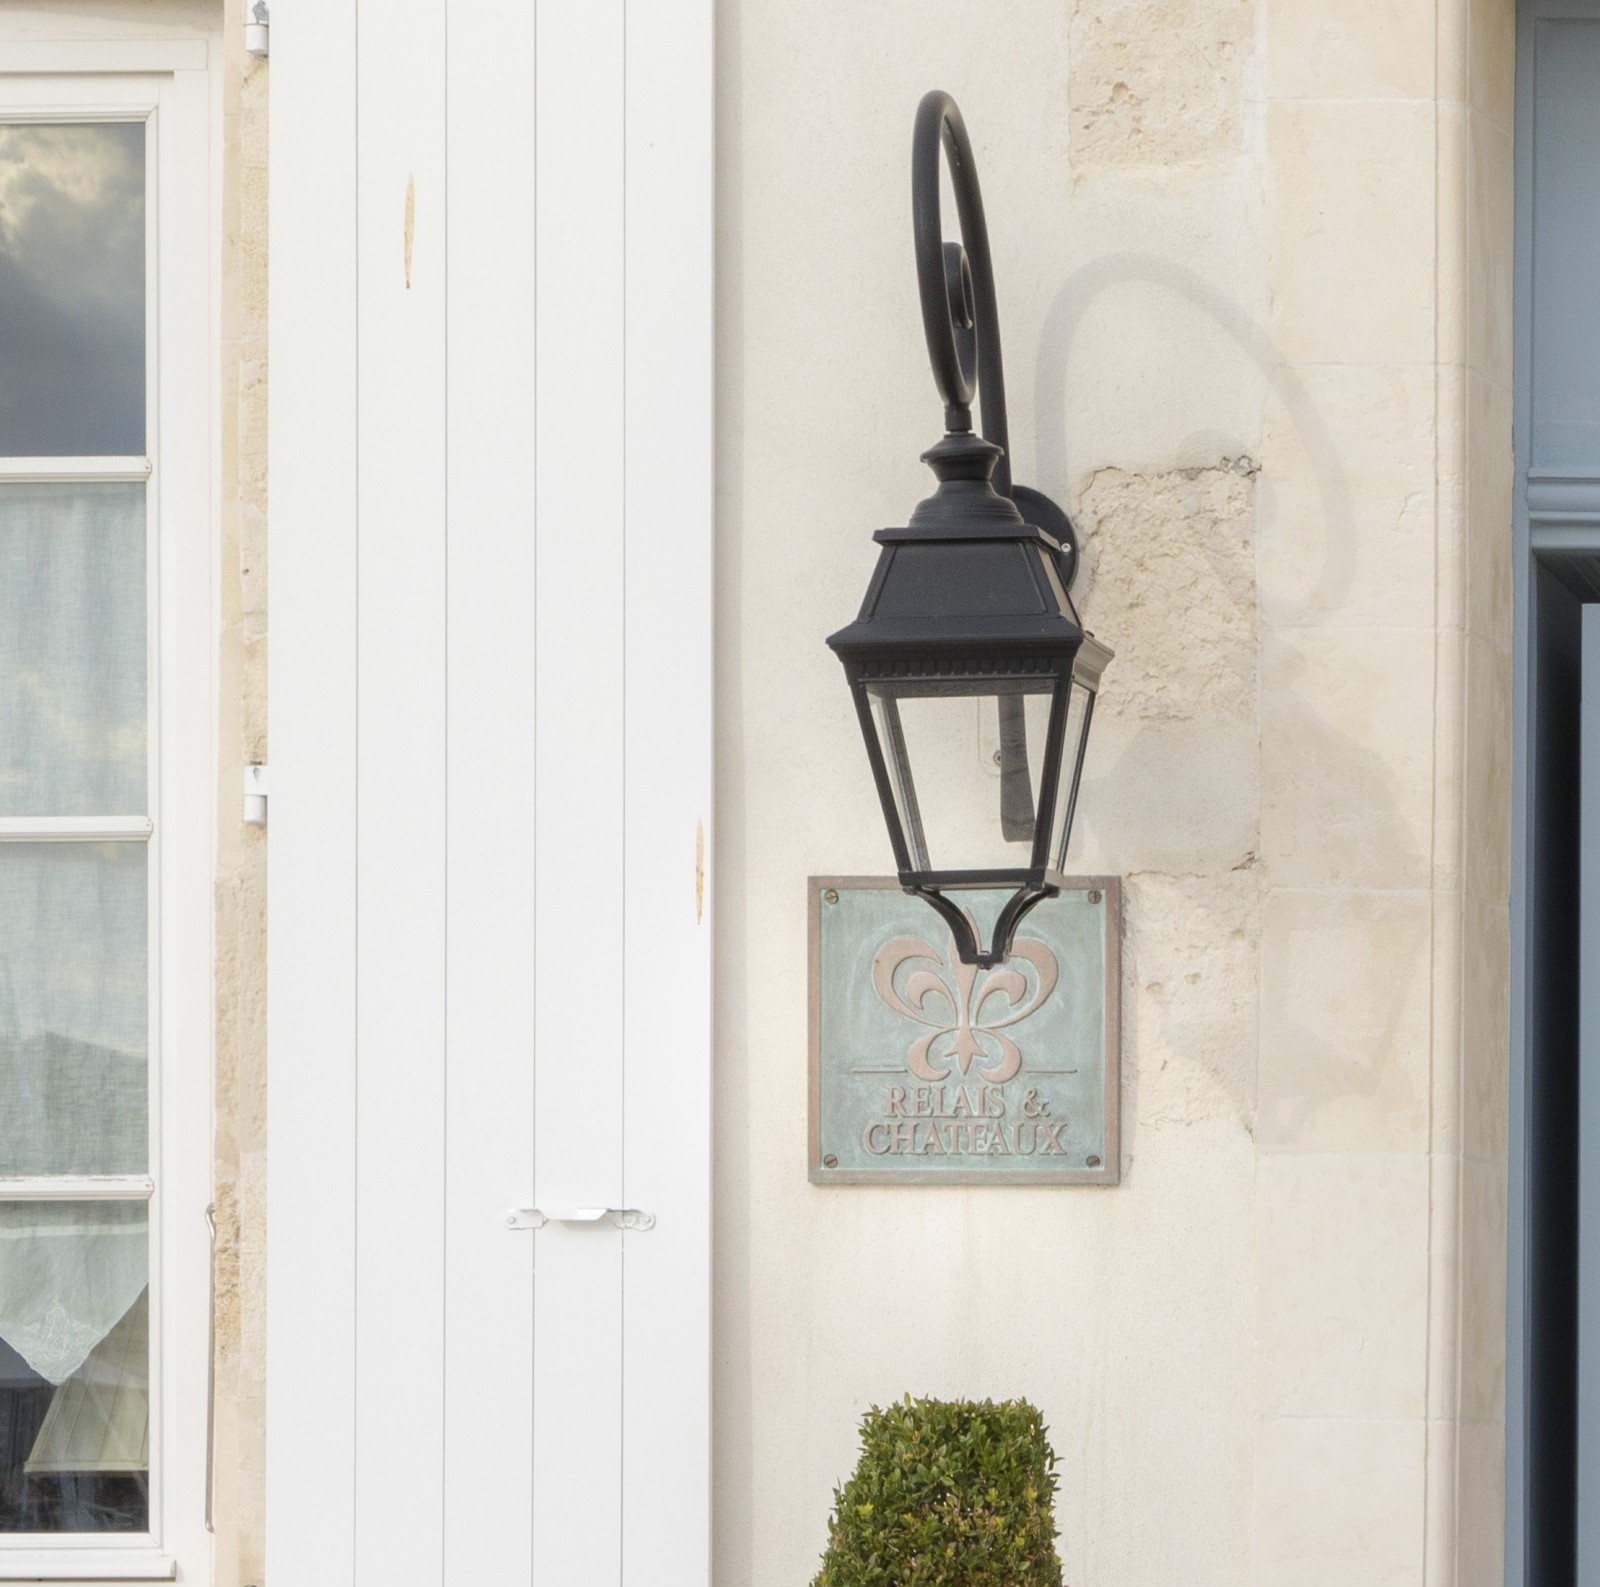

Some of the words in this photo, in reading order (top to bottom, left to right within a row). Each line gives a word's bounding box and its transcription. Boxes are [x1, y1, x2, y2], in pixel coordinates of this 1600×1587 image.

[884, 1085, 1006, 1118] RELAIS
[1022, 1088, 1051, 1118] &
[863, 1122, 1069, 1156] CHATEAUX
